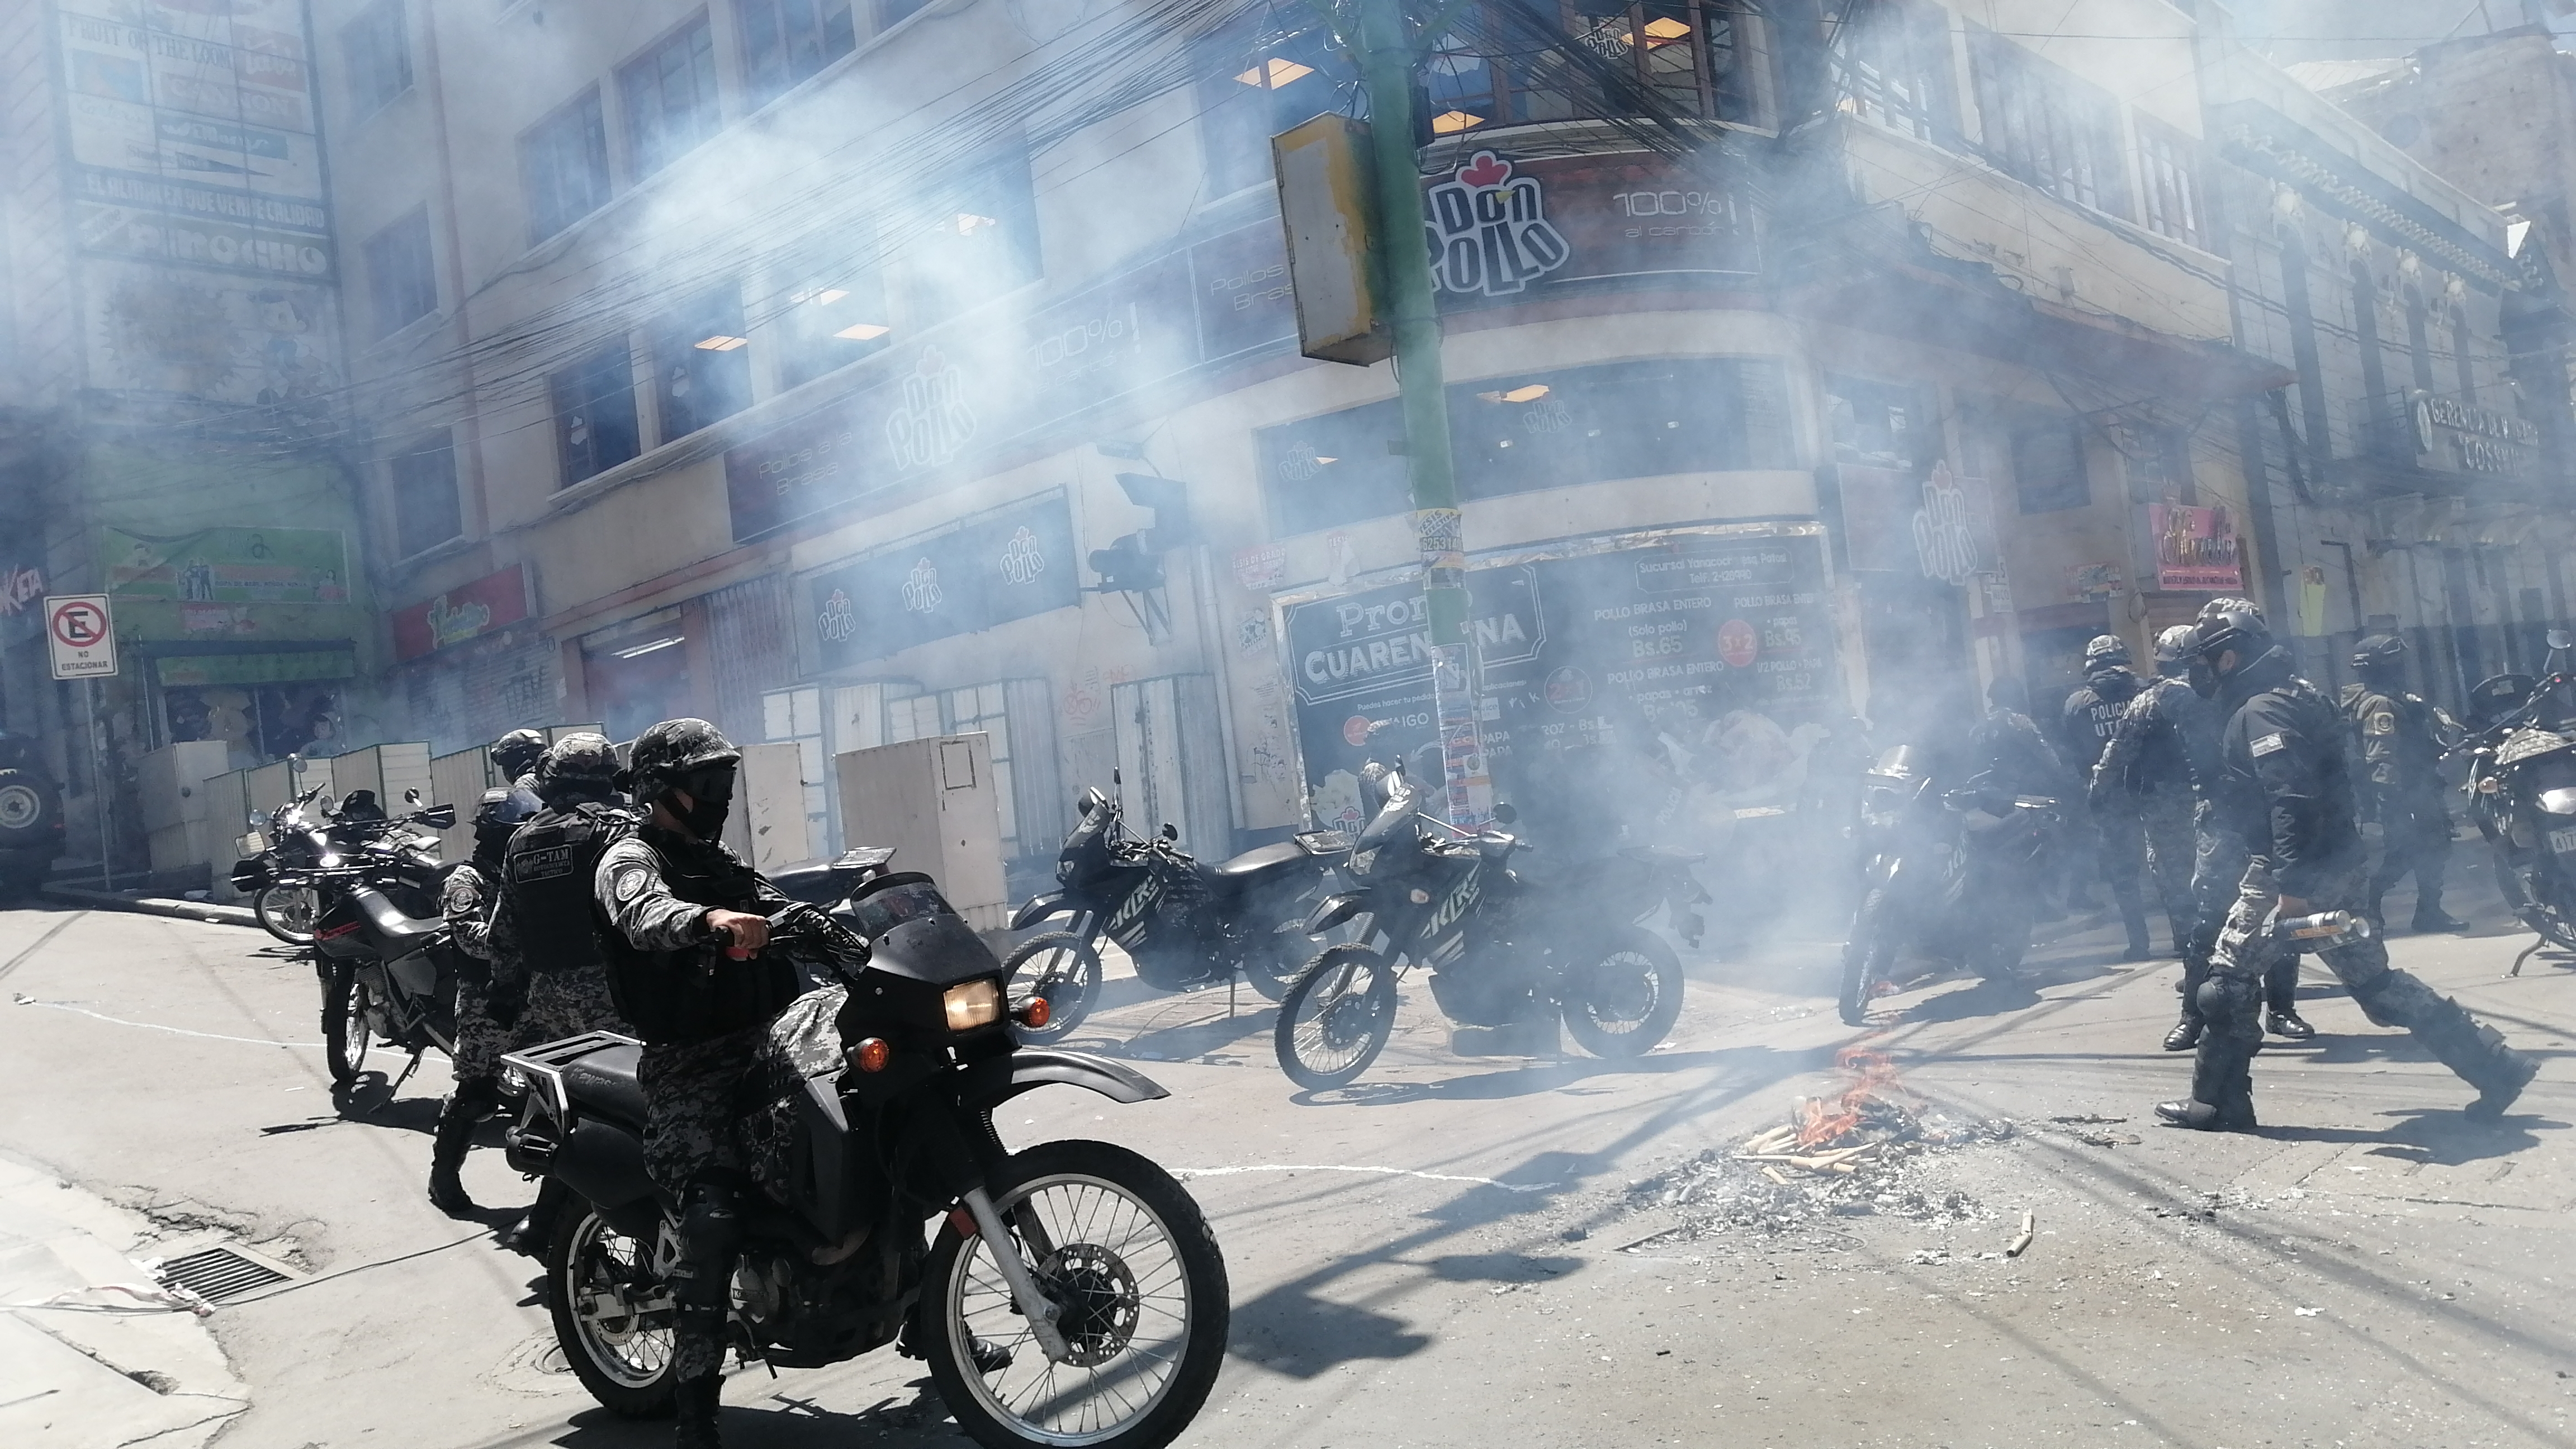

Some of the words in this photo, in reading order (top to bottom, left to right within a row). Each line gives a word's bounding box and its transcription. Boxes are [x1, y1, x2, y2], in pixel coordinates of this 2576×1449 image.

[68, 17, 121, 46] FRUIT
[153, 35, 189, 59] THE
[192, 41, 235, 69] LOOM
[185, 190, 215, 211] QUE
[267, 200, 325, 228] CALIDAD
[1625, 226, 1642, 238] al
[1210, 264, 1285, 296] Pollos
[1234, 283, 1292, 311] Bras
[759, 448, 813, 480] Pollos
[818, 441, 830, 454] a
[835, 432, 852, 448] la
[776, 462, 838, 496] Brasa
[1418, 510, 1442, 533] TESIS
[1639, 559, 1685, 574] Sucursal
[1687, 557, 1737, 570] Yanacoch
[1594, 609, 1631, 622] POLLO
[1634, 603, 1670, 615] BRASA
[1674, 596, 1712, 610] ENTERO
[1734, 597, 1761, 609] POLLO
[1765, 595, 1792, 607] BRASA
[1305, 613, 1527, 685] CUARENNA
[1632, 635, 1683, 658] Bs.65
[61, 660, 108, 671] ESTACIONAR
[1607, 670, 1644, 685] POLLO
[1647, 665, 1683, 679] BRASA
[1686, 660, 1724, 675] ENTERO
[1357, 702, 1381, 711] Puedes
[1382, 699, 1402, 707] hacer
[1412, 693, 1436, 703] pedido
[1637, 688, 1671, 704] papas
[1402, 712, 1429, 727] IGO
[533, 848, 570, 865] G-TAM
